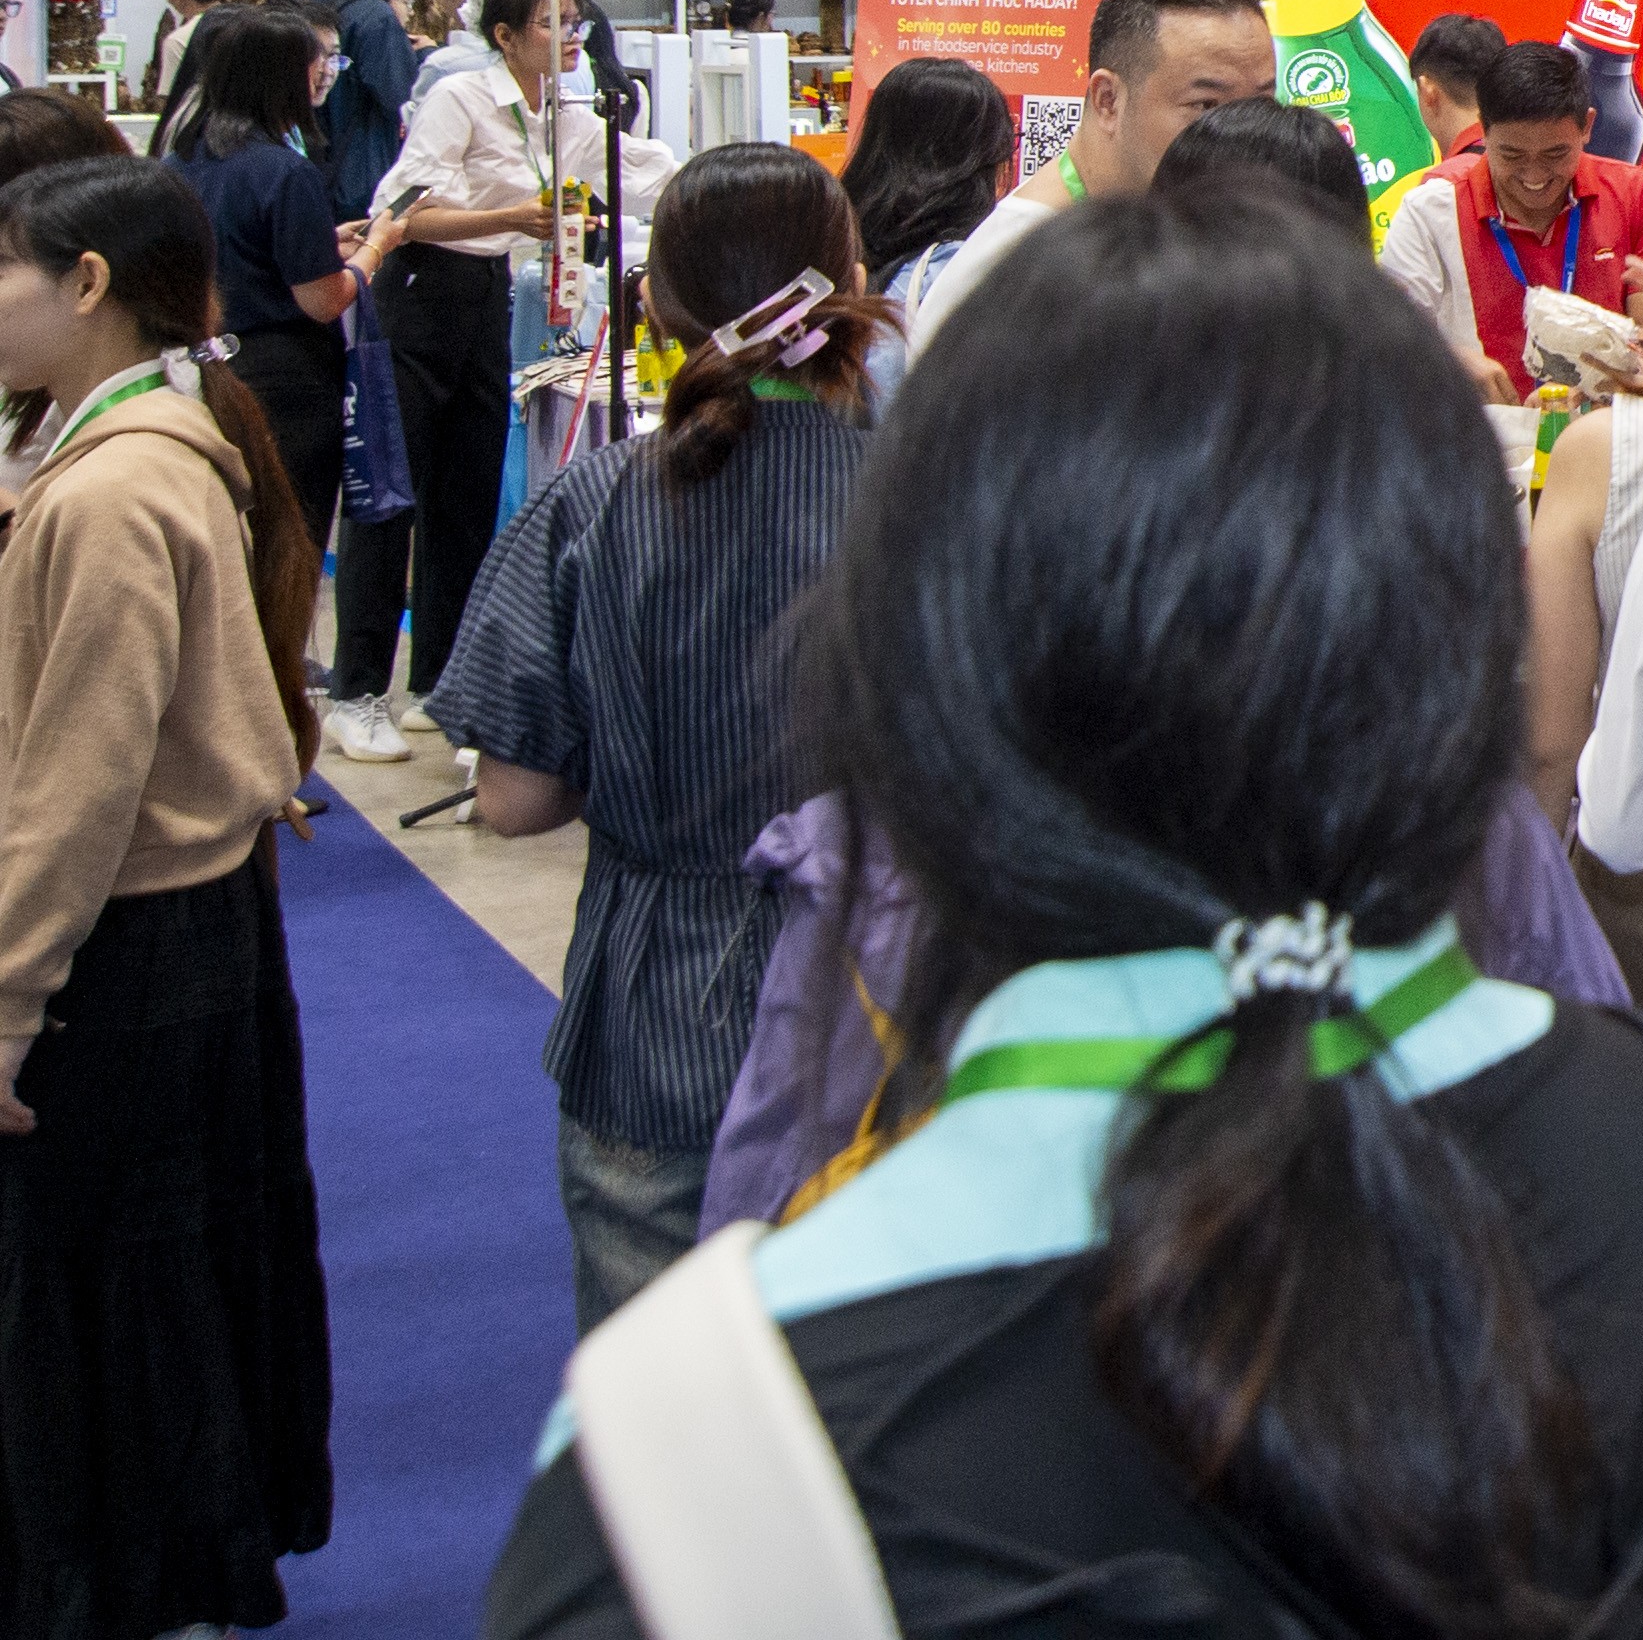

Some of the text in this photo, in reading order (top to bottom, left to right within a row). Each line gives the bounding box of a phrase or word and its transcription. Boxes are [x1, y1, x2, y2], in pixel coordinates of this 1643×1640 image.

[1587, 0, 1633, 34] haday
[897, 18, 1066, 38] Serving over 80 countries
[898, 38, 1063, 59] in the foodservice industry
[987, 59, 1040, 75] kitchens
[1359, 153, 1396, 185] ào
